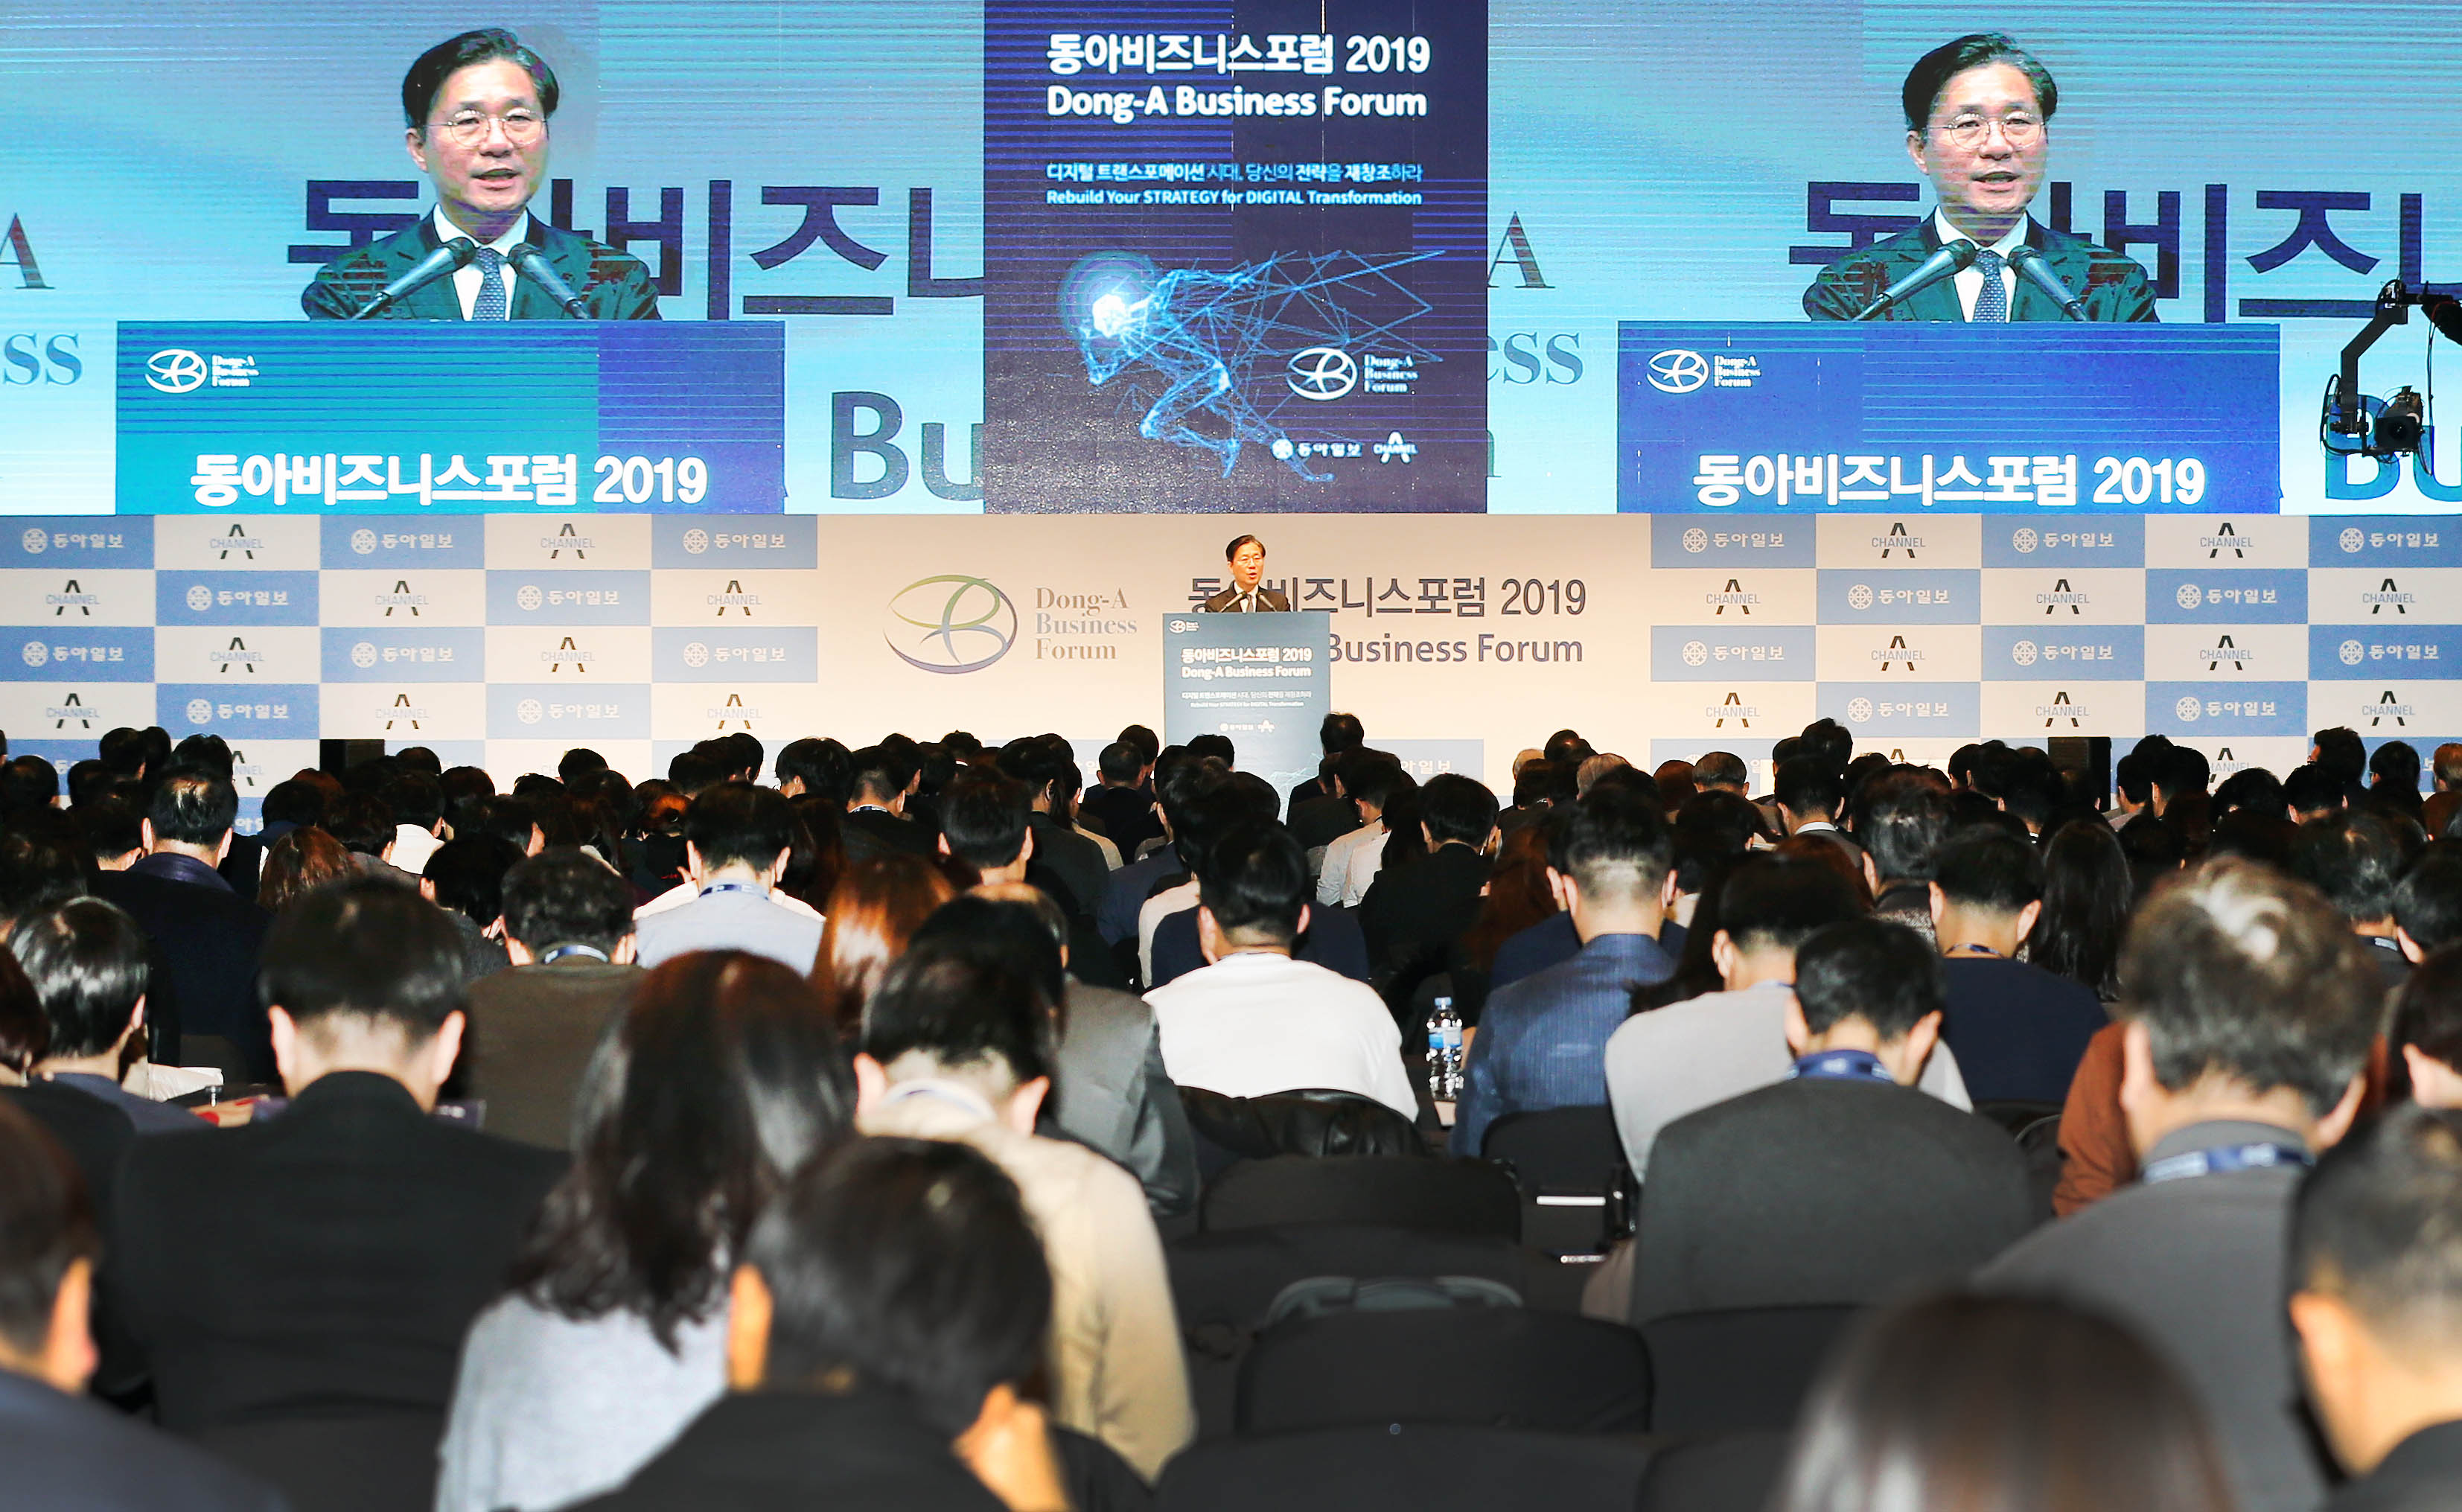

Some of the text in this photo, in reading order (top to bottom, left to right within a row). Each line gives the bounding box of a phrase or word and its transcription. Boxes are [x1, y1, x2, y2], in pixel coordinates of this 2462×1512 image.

[1046, 34, 1430, 74] 동아비즈니스포럼 2019
[1047, 85, 1428, 124] Dong-A Business Forum
[1046, 163, 1094, 182] 디지털
[1096, 163, 1205, 182] 트랜스포메이션
[1246, 163, 1294, 182] 당신의
[1295, 163, 1344, 182] 전략을
[1345, 163, 1423, 182] 재창조하라
[1046, 188, 1423, 205] Rebuild Your STRATEGY for DIGITAL Transformation
[191, 452, 707, 507] 동아비즈니스포럼 2019
[1692, 453, 2206, 508] 동아비즈니스포럼 2019
[53, 533, 124, 549] 동아일보
[210, 538, 264, 549] CHANNEL
[381, 534, 453, 549] 동아일보
[540, 538, 595, 549] CHANNEL
[713, 534, 786, 549] 동아일보
[1712, 533, 1785, 548] 동아일보
[1872, 537, 1926, 547] CHANNEL
[2042, 532, 2114, 548] 동아일보
[2199, 537, 2254, 547] CHANNEL
[2368, 532, 2440, 548] 동아일보
[46, 594, 101, 605] CHANNEL
[217, 590, 289, 606] 동아일보
[376, 595, 430, 605] CHANNEL
[546, 590, 620, 605] 동아일보
[707, 595, 762, 605] CHANNEL
[1036, 587, 1129, 615] Dong-A
[1188, 577, 1586, 616] 동비즈니스포럼 2019
[1706, 593, 1761, 604] CHANNEL
[1878, 590, 1950, 605] 동아일보
[2036, 593, 2091, 604] CHANNEL
[2206, 589, 2277, 604] 동아일보
[2362, 593, 2416, 603] CHANNEL
[1036, 616, 1138, 634] Business
[52, 646, 125, 663] 동아일보
[381, 647, 454, 663] 동아일보
[714, 648, 786, 663] 동아일보
[1036, 639, 1116, 660] Forum
[1181, 648, 1313, 663] 동아비즈니스포럼 2019
[1330, 634, 1583, 662] Business Forum
[1712, 646, 1785, 661] 동아일보
[1872, 650, 1925, 660] CHANNEL
[2041, 645, 2114, 660] 동아일보
[2199, 650, 2254, 660] CHANNEL
[2368, 645, 2439, 660] 동아일보
[211, 651, 264, 662] CHANNEL
[542, 651, 596, 662] CHANNEL
[1181, 666, 1312, 680] Dong-A Business Forum
[46, 707, 101, 718] CHANNEL
[217, 704, 289, 719] 동아일보
[376, 709, 430, 719] CHANNEL
[547, 704, 620, 719] 동아일보
[708, 708, 762, 718] CHANNEL
[1706, 706, 1760, 717] CHANNEL
[1877, 702, 1949, 718] 동아일보
[2035, 706, 2090, 716] CHANNEL
[2205, 701, 2277, 717] 동아일보
[2361, 705, 2416, 715] CHANNEL
[1400, 760, 1453, 774] 아일보
